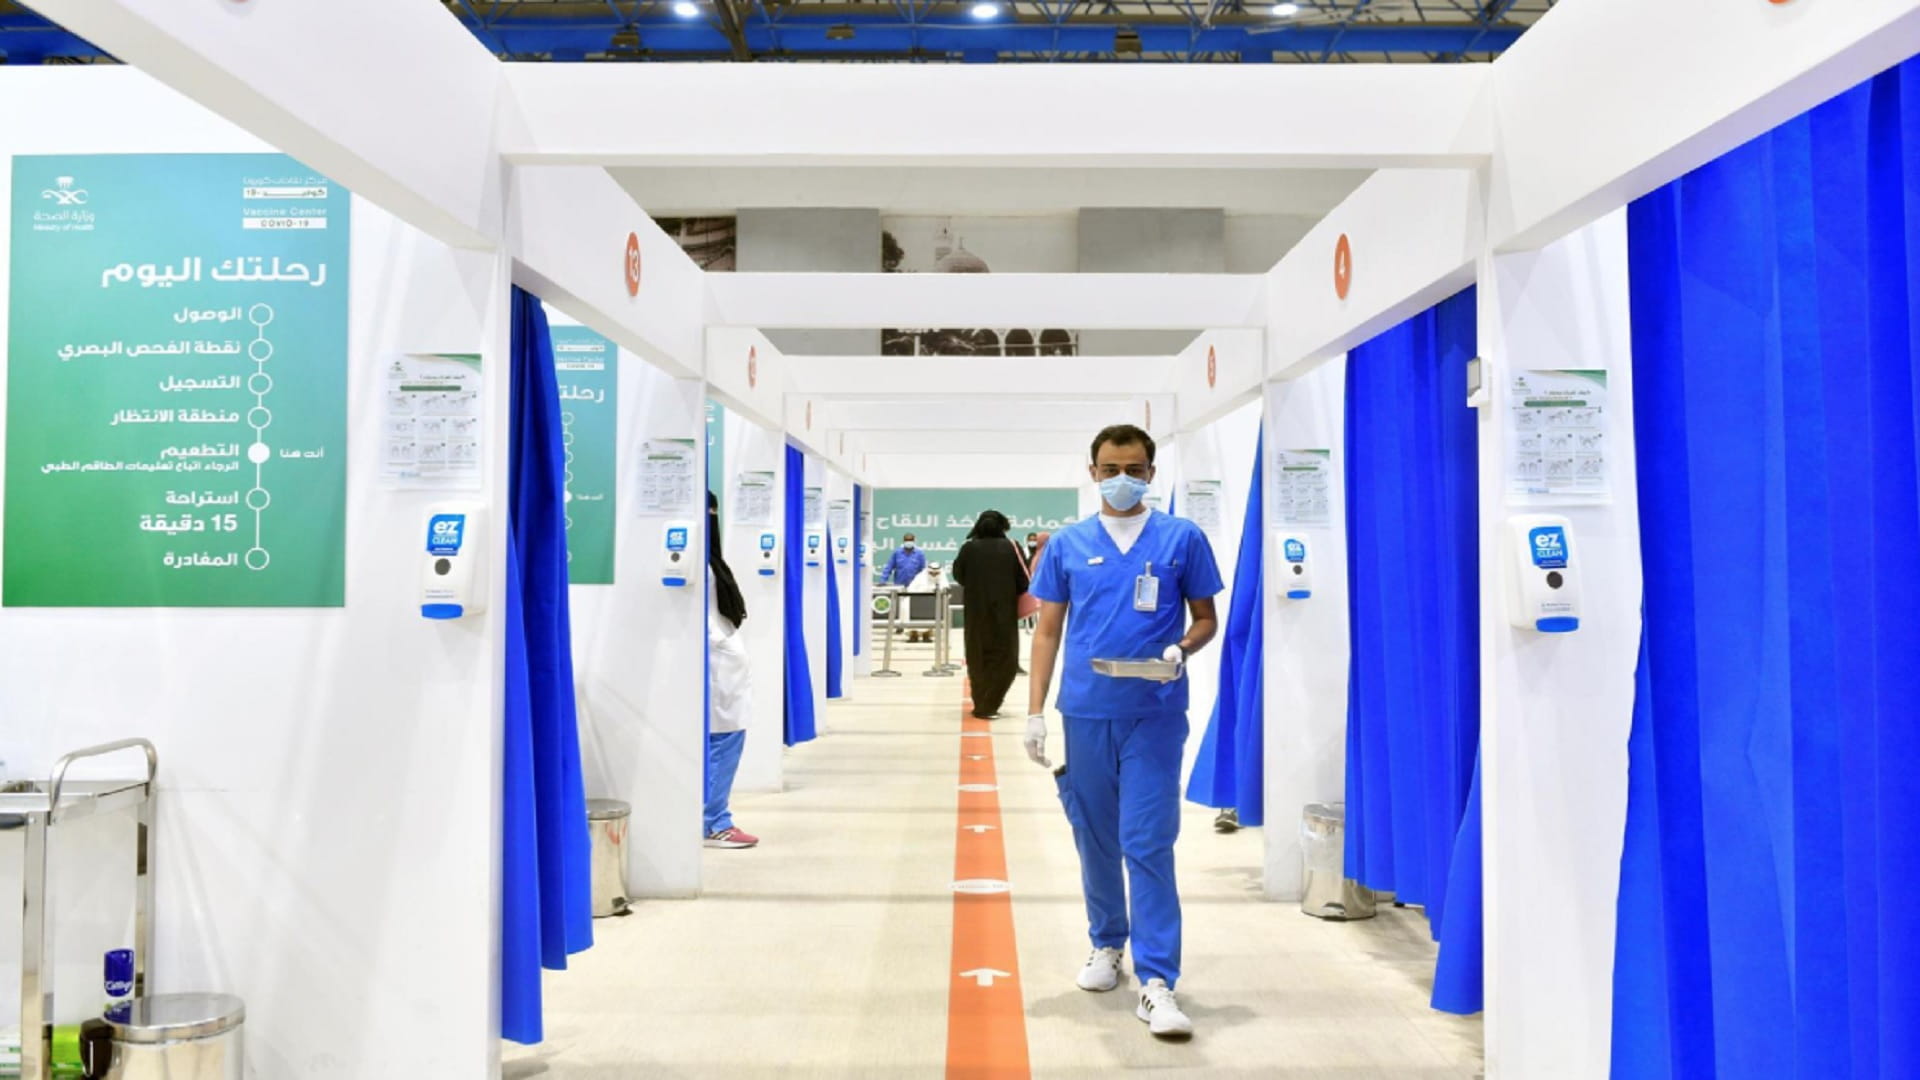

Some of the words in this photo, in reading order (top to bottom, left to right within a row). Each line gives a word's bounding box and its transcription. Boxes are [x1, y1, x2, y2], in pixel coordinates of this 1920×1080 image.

[34, 208, 70, 221] الصحة
[71, 208, 95, 223] وزارة
[243, 207, 287, 217] Vaccine
[289, 207, 328, 217] Center
[260, 218, 310, 228] COVID-19
[101, 256, 202, 288] اليوم
[210, 256, 327, 287] رحلتك
[629, 248, 638, 282] 13
[173, 307, 242, 323] الوصول
[57, 340, 123, 361] البصري
[126, 340, 191, 357] الفحص
[193, 340, 242, 355] نقطة
[158, 375, 241, 392] التسجيل
[558, 385, 605, 403] رحلت
[109, 409, 175, 426] الانتظار
[177, 408, 240, 423] منطقة
[160, 444, 240, 460] التطعيم
[280, 448, 302, 459] هنا
[80, 461, 124, 474] الطاقم
[124, 461, 174, 472] تعليمات
[174, 461, 202, 473] اتباع
[203, 460, 240, 473] الرجاء
[165, 490, 239, 508] استراحة
[139, 513, 205, 535] دقيقة
[211, 513, 238, 533] 15
[433, 521, 460, 534] ez
[876, 513, 939, 530] اللقاح
[1534, 533, 1561, 548] ez
[163, 551, 238, 569] المغادرة
[1536, 549, 1563, 558] CLEAN
